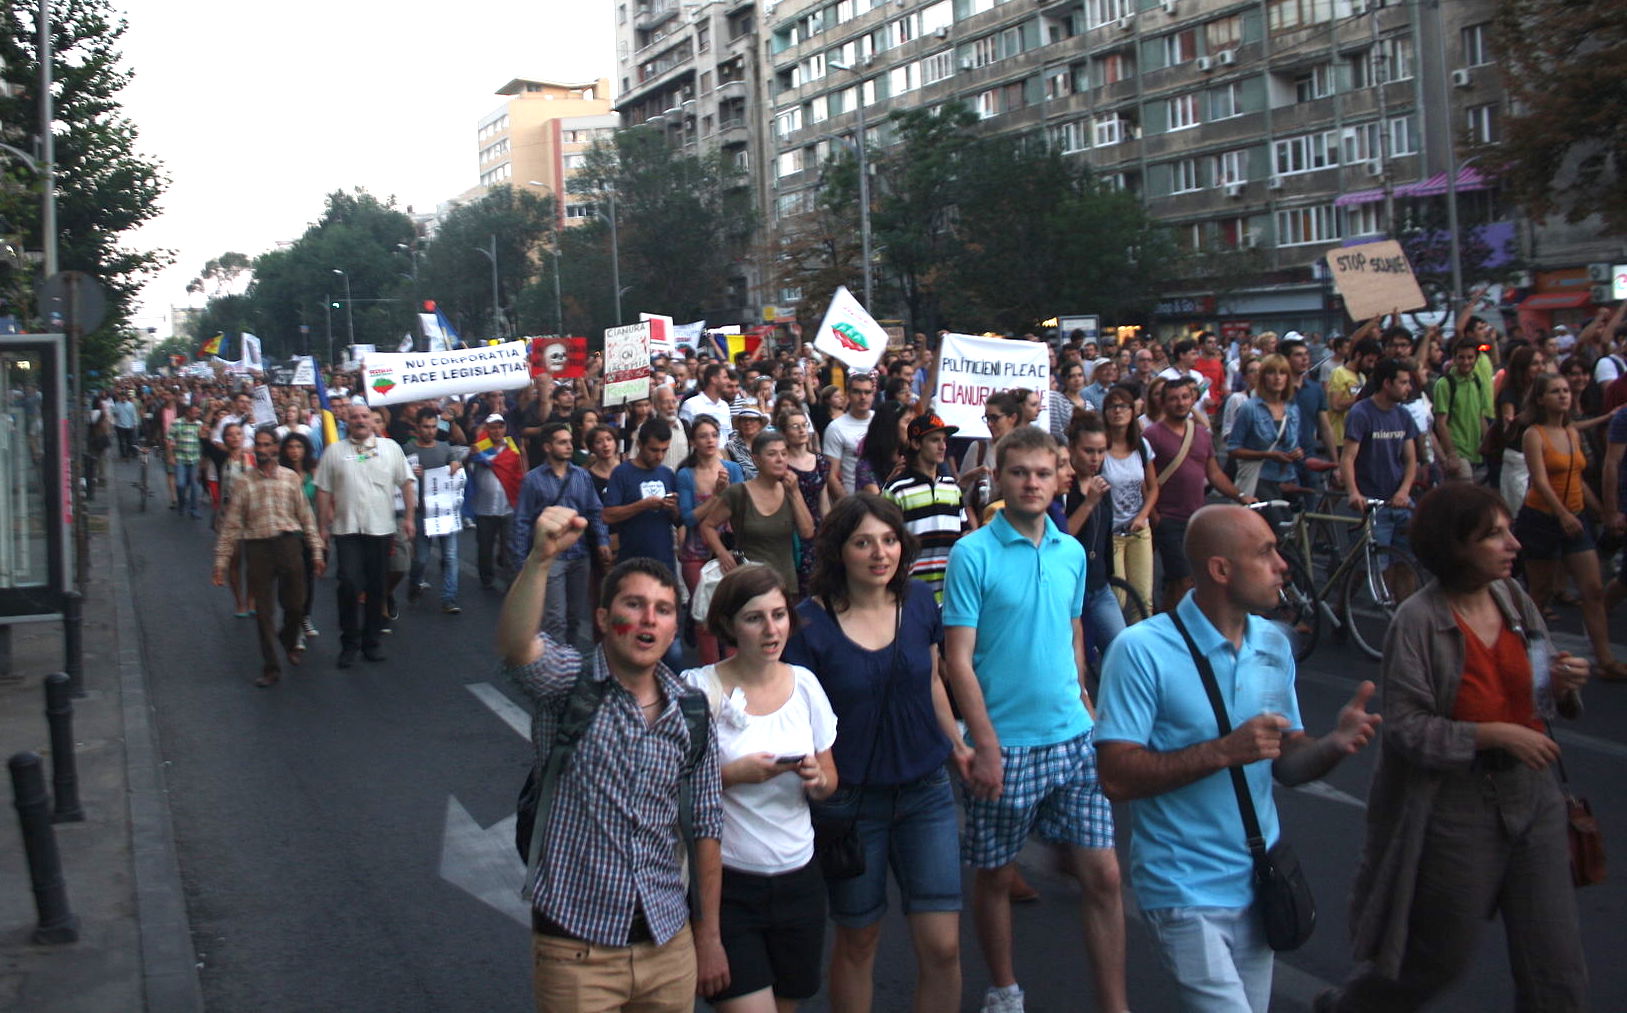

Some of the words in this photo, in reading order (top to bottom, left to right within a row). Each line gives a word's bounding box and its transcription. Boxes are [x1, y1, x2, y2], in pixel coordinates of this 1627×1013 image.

[1337, 252, 1366, 273] STOP
[405, 359, 421, 369] NU
[402, 371, 437, 385] FACE
